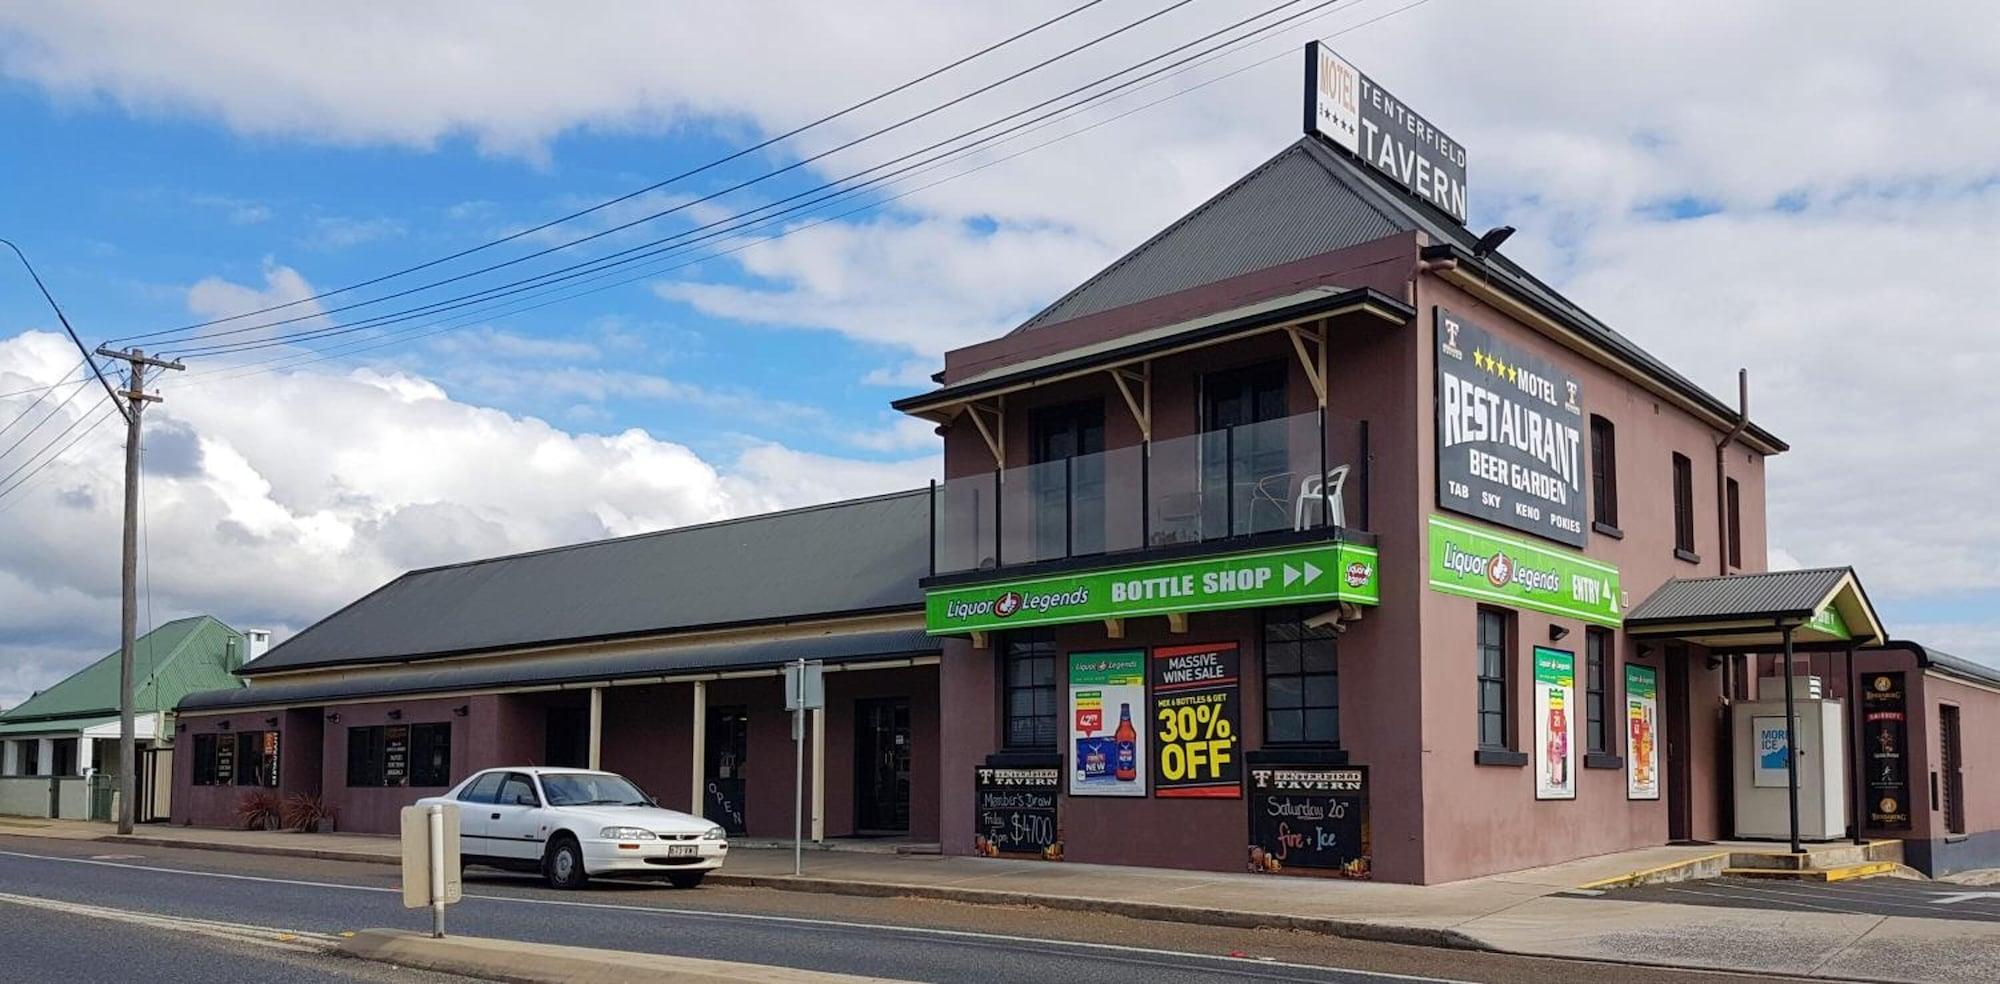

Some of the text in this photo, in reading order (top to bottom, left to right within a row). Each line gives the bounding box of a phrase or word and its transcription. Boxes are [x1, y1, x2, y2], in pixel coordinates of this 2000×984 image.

[1320, 53, 1356, 113] MOTEL
[1361, 79, 1466, 168] TENTERFIELD
[1361, 117, 1466, 221] TAVERN
[1517, 366, 1558, 406] MOTEL
[1443, 371, 1580, 493] RESTAURANT
[1469, 448, 1567, 506] BEER GARDEN
[1448, 480, 1581, 534] TAB SKY KENO POKIES
[1111, 567, 1272, 603] BOTTLE SHOP
[1443, 541, 1600, 605] Liquor Legends ENTRY
[947, 586, 1089, 621] Liquor Legends
[1163, 665, 1225, 684] WINE SALE
[1169, 653, 1217, 670] MASSIVE
[1176, 695, 1206, 706] BOTTLES
[1212, 693, 1227, 702] GET
[1158, 703, 1231, 743] 30%
[1762, 729, 1788, 740] MOR
[1161, 739, 1231, 781] OFF
[1761, 740, 1778, 750] ICE
[1086, 762, 1106, 772] NEW
[1273, 770, 1362, 781] TENTERFIELD
[1025, 793, 1052, 807] Draw
[1273, 781, 1362, 790] TAVERN
[709, 783, 742, 824] OPEN
[1267, 796, 1324, 820] Saturday
[1010, 811, 1053, 846] $4700
[1316, 826, 1337, 851] Ice
